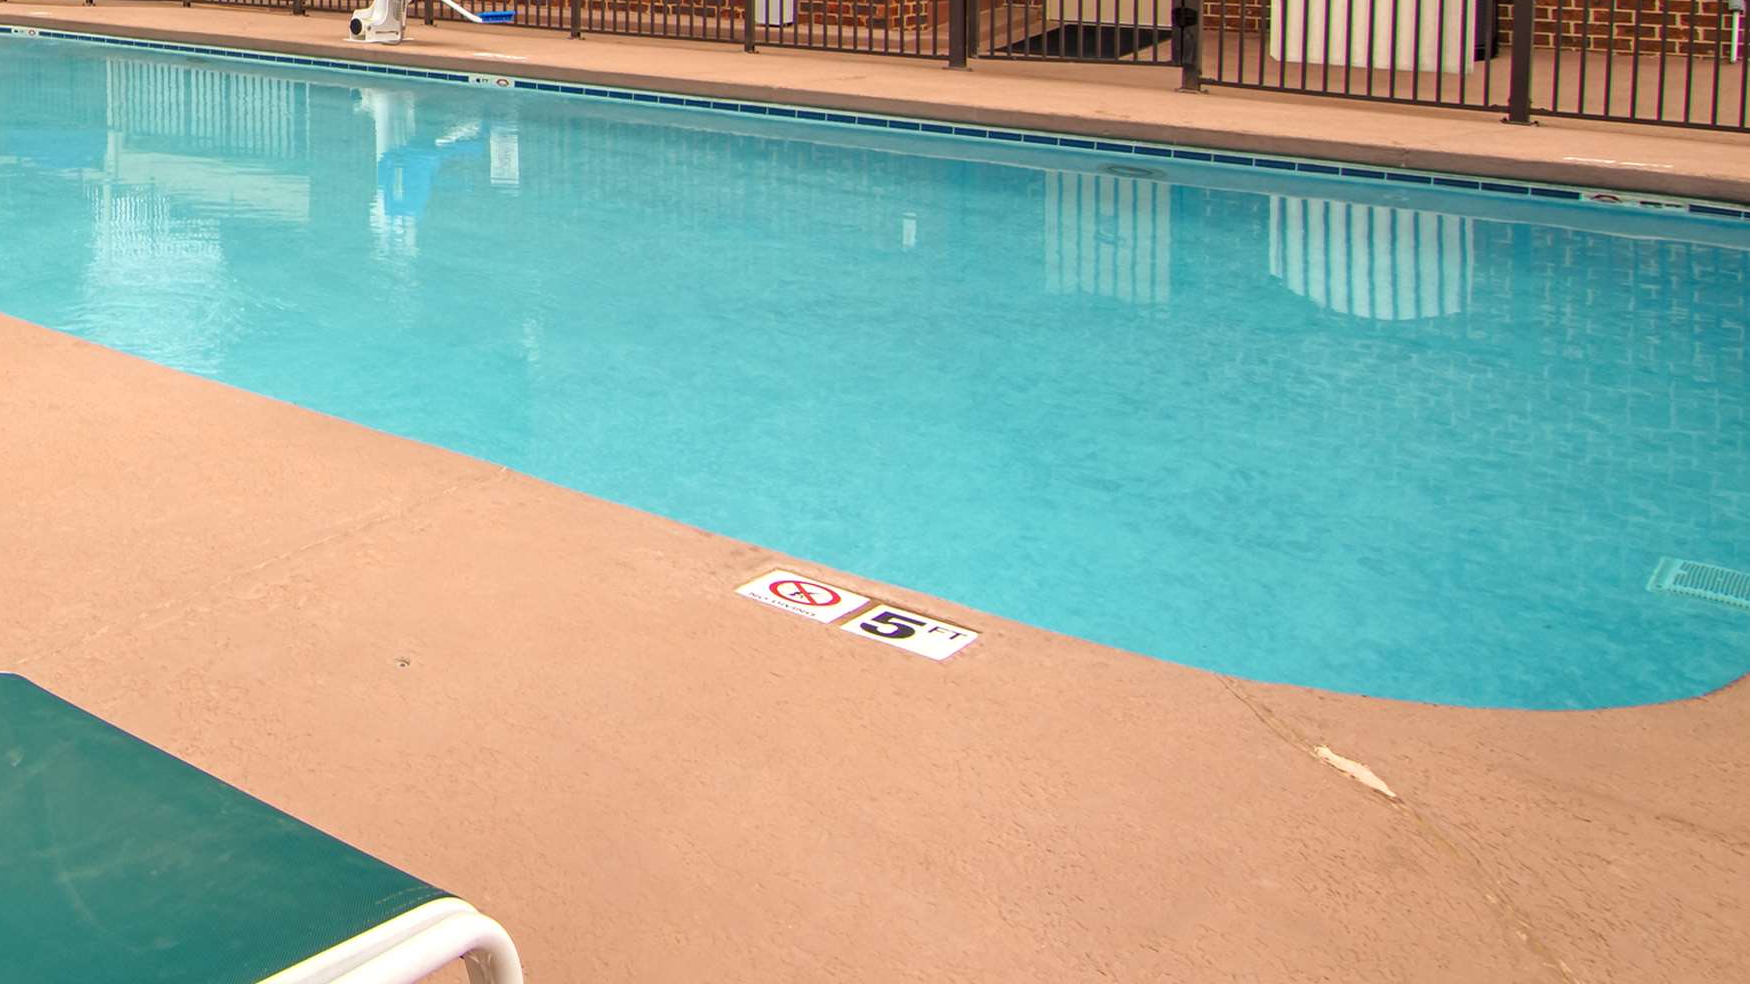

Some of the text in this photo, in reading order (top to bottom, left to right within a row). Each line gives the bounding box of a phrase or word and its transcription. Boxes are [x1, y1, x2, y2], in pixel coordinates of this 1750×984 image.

[748, 591, 769, 601] NO
[859, 611, 968, 640] 5 FT
